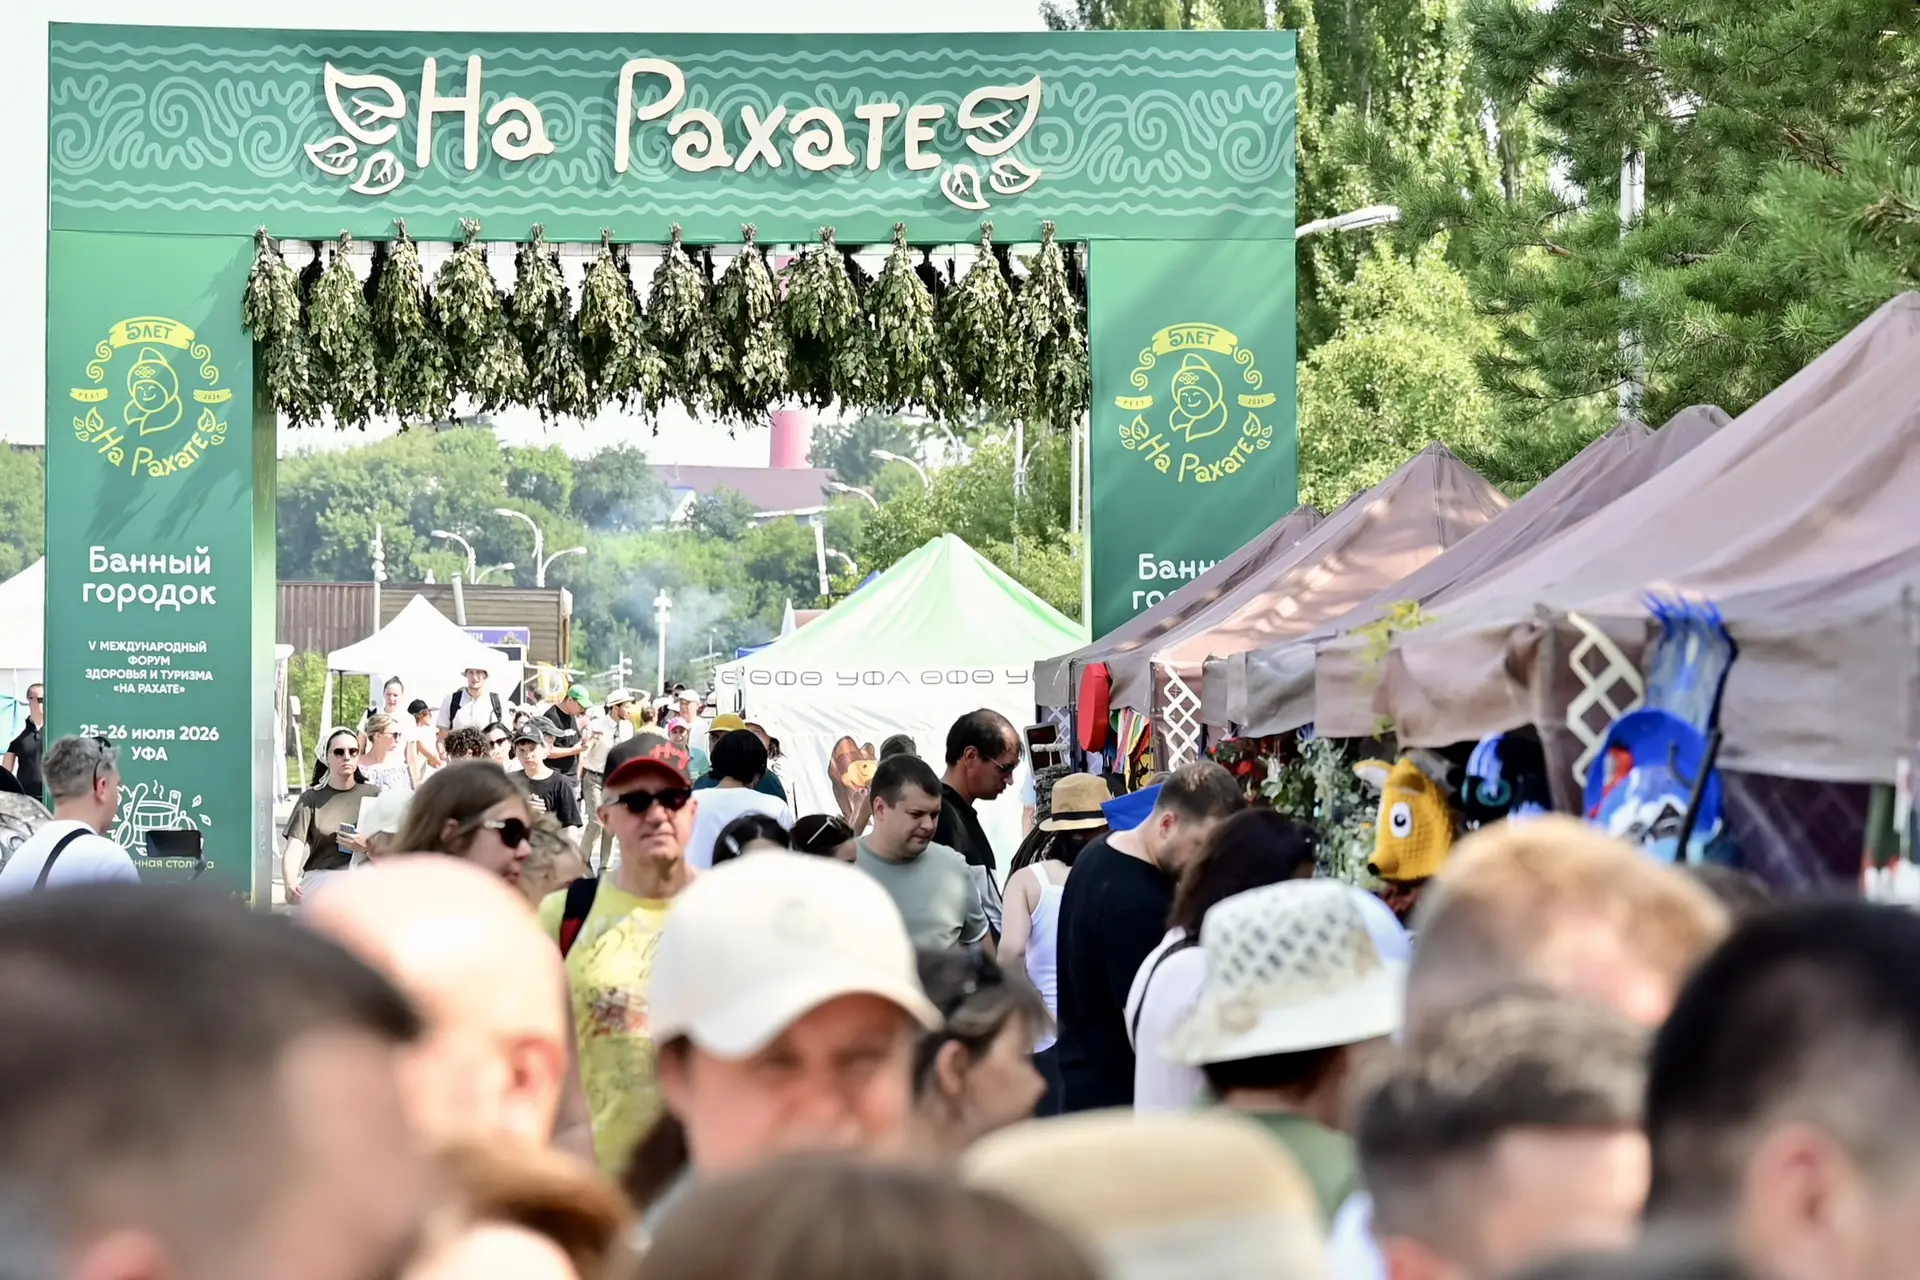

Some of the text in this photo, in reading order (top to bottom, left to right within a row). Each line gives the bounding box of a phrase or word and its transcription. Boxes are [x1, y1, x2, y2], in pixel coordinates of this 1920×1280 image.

[415, 55, 556, 171] На
[91, 426, 125, 467] На
[1137, 433, 1171, 474] На
[89, 545, 211, 575] Банный
[1138, 553, 1222, 580] Банн
[82, 582, 217, 613] городок
[88, 640, 207, 654] V МЕЖДУНАРОДНЫЙ
[127, 655, 171, 666] ФОРУМ
[85, 668, 214, 681] ЗДОРОВЬЯ И ТУРИЗМА
[113, 683, 186, 694] «НА РАХАТЕ»
[131, 728, 176, 740] июля
[179, 726, 220, 741] 2026
[131, 746, 168, 761] УФА
